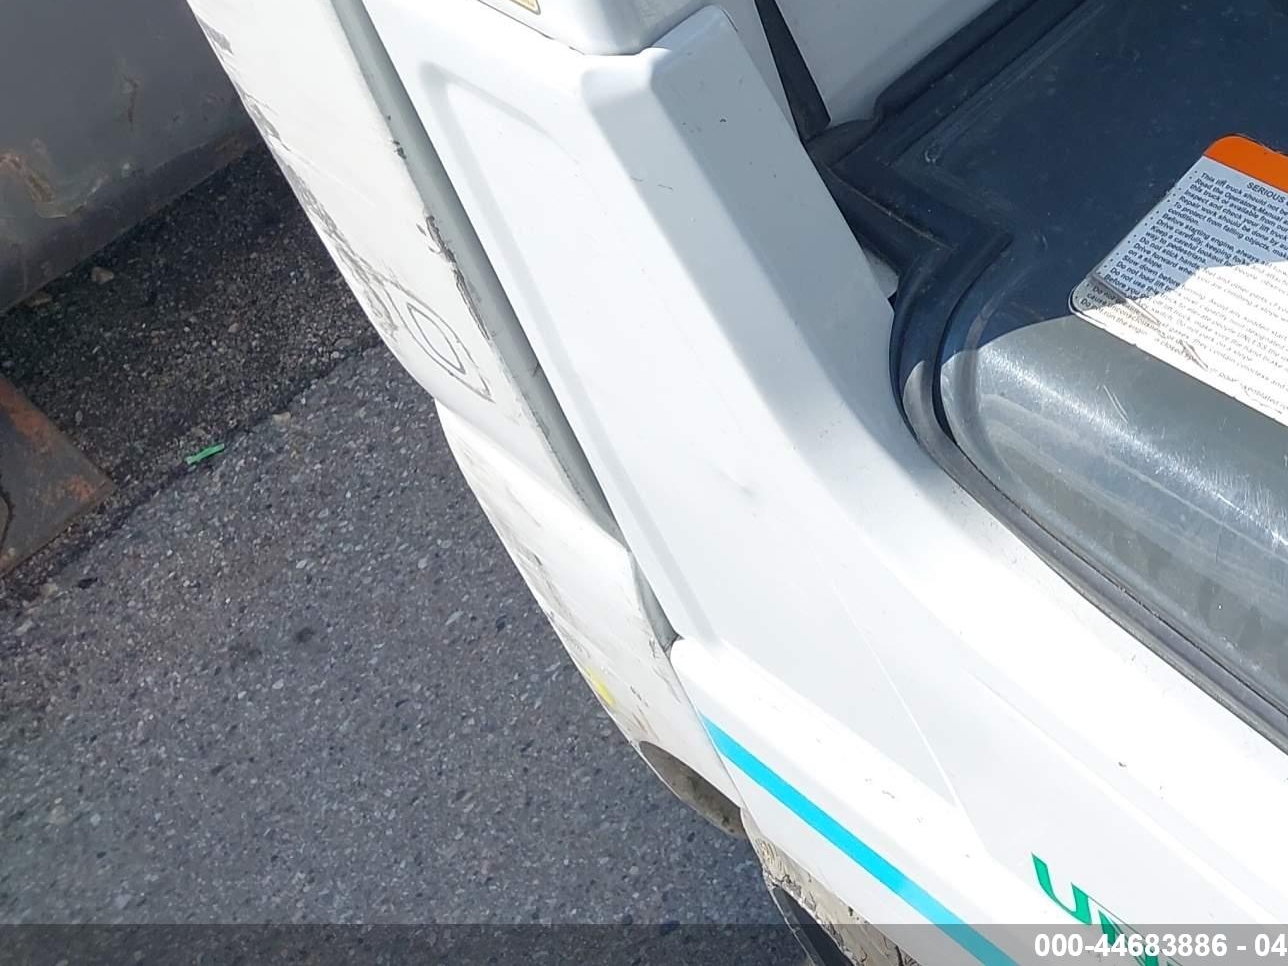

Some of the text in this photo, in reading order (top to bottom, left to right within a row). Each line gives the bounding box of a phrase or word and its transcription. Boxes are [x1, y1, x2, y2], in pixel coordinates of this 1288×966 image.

[1194, 178, 1213, 189] Read
[1211, 186, 1224, 195] the
[1257, 207, 1283, 222] Manual
[1200, 172, 1217, 182] This
[1224, 183, 1243, 194] truck
[1242, 191, 1267, 206] should
[1266, 202, 1280, 211] not
[1245, 181, 1286, 203] SERIOUS
[1181, 205, 1207, 220] protect
[1205, 217, 1223, 228] from
[1182, 189, 1210, 205] Inspect
[1208, 201, 1222, 210] and
[1221, 207, 1242, 219] check
[1241, 216, 1259, 228] your
[1258, 224, 1269, 232] lift
[1269, 229, 1288, 240] truck
[1188, 184, 1203, 193] this
[1202, 190, 1220, 201] truck
[1228, 202, 1259, 219] available
[1258, 216, 1276, 226] from
[1275, 223, 1288, 232] our
[1161, 213, 1185, 227] Before
[1177, 195, 1279, 245] Repair work should be done by
[1138, 237, 1180, 259] Do not stick
[1144, 230, 1168, 245] way to
[1149, 225, 1169, 237] Keep
[1172, 236, 1198, 251] careful
[1196, 247, 1224, 263] lookout
[1155, 219, 1233, 258] Drive keeping
[1126, 249, 1138, 257] on
[1132, 243, 1152, 255] Drive
[1150, 252, 1178, 267] forward
[1109, 267, 1121, 276] Do
[1120, 272, 1133, 282] not
[1132, 279, 1147, 289] use
[1116, 261, 1164, 288] Do not load lift
[1139, 263, 1158, 276] down
[1103, 274, 1128, 289] Before
